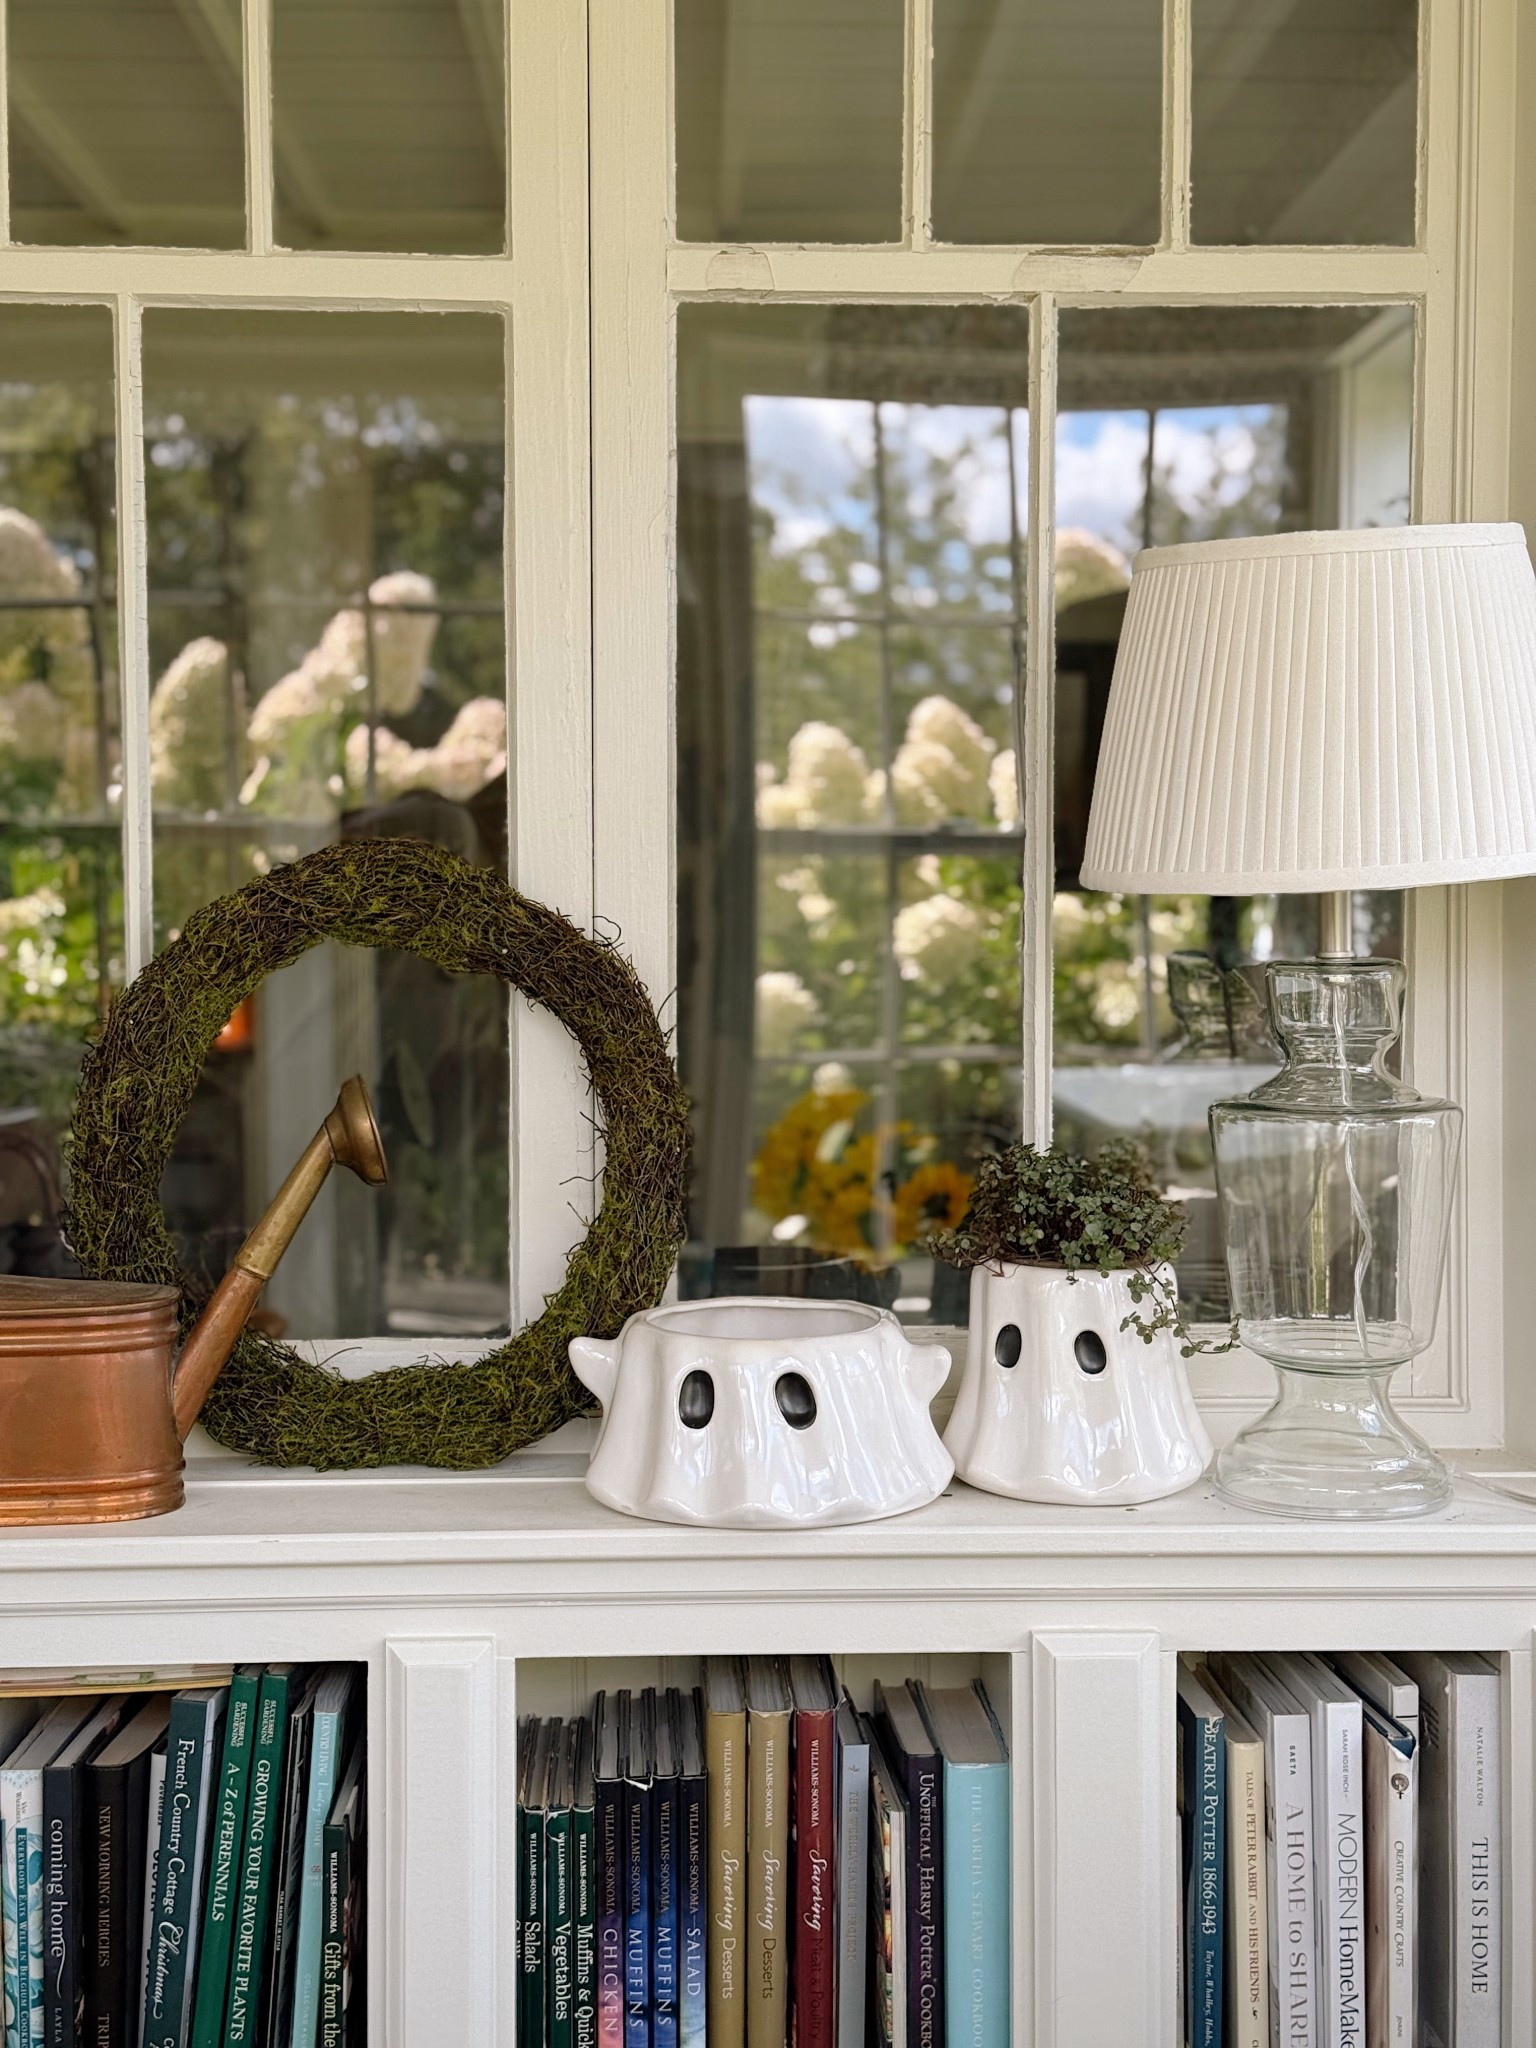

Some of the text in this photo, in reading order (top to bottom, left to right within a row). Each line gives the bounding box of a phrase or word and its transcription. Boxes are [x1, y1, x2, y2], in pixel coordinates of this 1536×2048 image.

[231, 1701, 242, 1748] GARDENING
[260, 1698, 271, 1746] GARDENING
[1289, 1745, 1297, 1776] SAETA
[174, 1738, 196, 1790] French
[225, 1788, 239, 1799] Z
[228, 1762, 241, 1775] A
[722, 1740, 732, 1828] WILLIAMS-SONOMA
[765, 1739, 774, 1828] WILLIAMS-SONOMA
[810, 1739, 820, 1828] WILLIAMS-SONOMA
[971, 1784, 982, 1815] THE
[1245, 1770, 1254, 1797] TALES
[1247, 1798, 1255, 1810] OF
[1476, 1726, 1484, 1807] NATALIE WALTON
[168, 1793, 191, 1855] Country
[223, 1802, 236, 1820] of
[919, 1773, 935, 1860] UNOFFICIAL
[1202, 1722, 1219, 1935] BEATRIX POTTER 1866-1943
[1246, 1813, 1257, 1851] PETER
[18, 1834, 27, 1891] EVERYBODY
[47, 1819, 68, 1957] coming home
[98, 1805, 112, 1968] NEW MORNING MERCIES
[162, 1857, 186, 1915] Cottage
[211, 1821, 235, 1921] PERENNIALS
[330, 1851, 338, 1934] WILLIAMS-SONOMA
[529, 1832, 537, 1917] WILLIAMS-SONOMA
[558, 1831, 566, 1916] WILLIAMS-SONOMA
[579, 1833, 587, 1917] WILLIAMS-SONOMA
[604, 1803, 616, 1916] WILLIAMS-SONOMA
[631, 1803, 641, 1915] WILLIAMS-SONOMA
[660, 1801, 670, 1913] WILLIAMS-SONOMA
[689, 1802, 699, 1915] WILLIAMS-SONOMA
[715, 1849, 740, 1932] Savoring
[756, 1849, 781, 1932] Savoring
[803, 1849, 828, 1932] Savoring
[971, 1821, 983, 1887] MARTHA
[1247, 1853, 1258, 1901] RABBIT
[1338, 1813, 1358, 1919] MODERN
[18, 1894, 27, 1916] EATS
[19, 1921, 28, 1946] WELL
[230, 1759, 271, 2041] GROWING YOUR FAVORITE PLANTS
[972, 1892, 983, 1961] STEWART
[1248, 1928, 1259, 1949] HIS
[1286, 1802, 1309, 2048] A HOME to SHARE
[1394, 1840, 1405, 1967] CREATIVE COUNTRY CRAFTS
[1471, 1836, 1489, 1994] THIS IS HOME
[20, 1950, 28, 1960] IN
[20, 1965, 29, 2007] BELGIUM
[153, 1921, 184, 2020] Christmas
[524, 1921, 542, 1973] Salads
[551, 1920, 572, 2020] Vegetables
[574, 1923, 594, 2048] Muffins & Quick
[603, 1928, 619, 2032] CHICKEN
[628, 1928, 644, 2027] MUFFINS
[657, 1926, 672, 2025] MUFFINS
[687, 1927, 701, 1996] SALAD
[722, 1938, 737, 1999] Desserts
[762, 1938, 777, 1999] Desserts
[811, 1938, 824, 1974] Meat
[1249, 1950, 1260, 2003] FRIENDS
[54, 2007, 63, 2043] LAYLA
[324, 1941, 342, 2048] Gifts from the
[808, 1991, 824, 2038] Poultry
